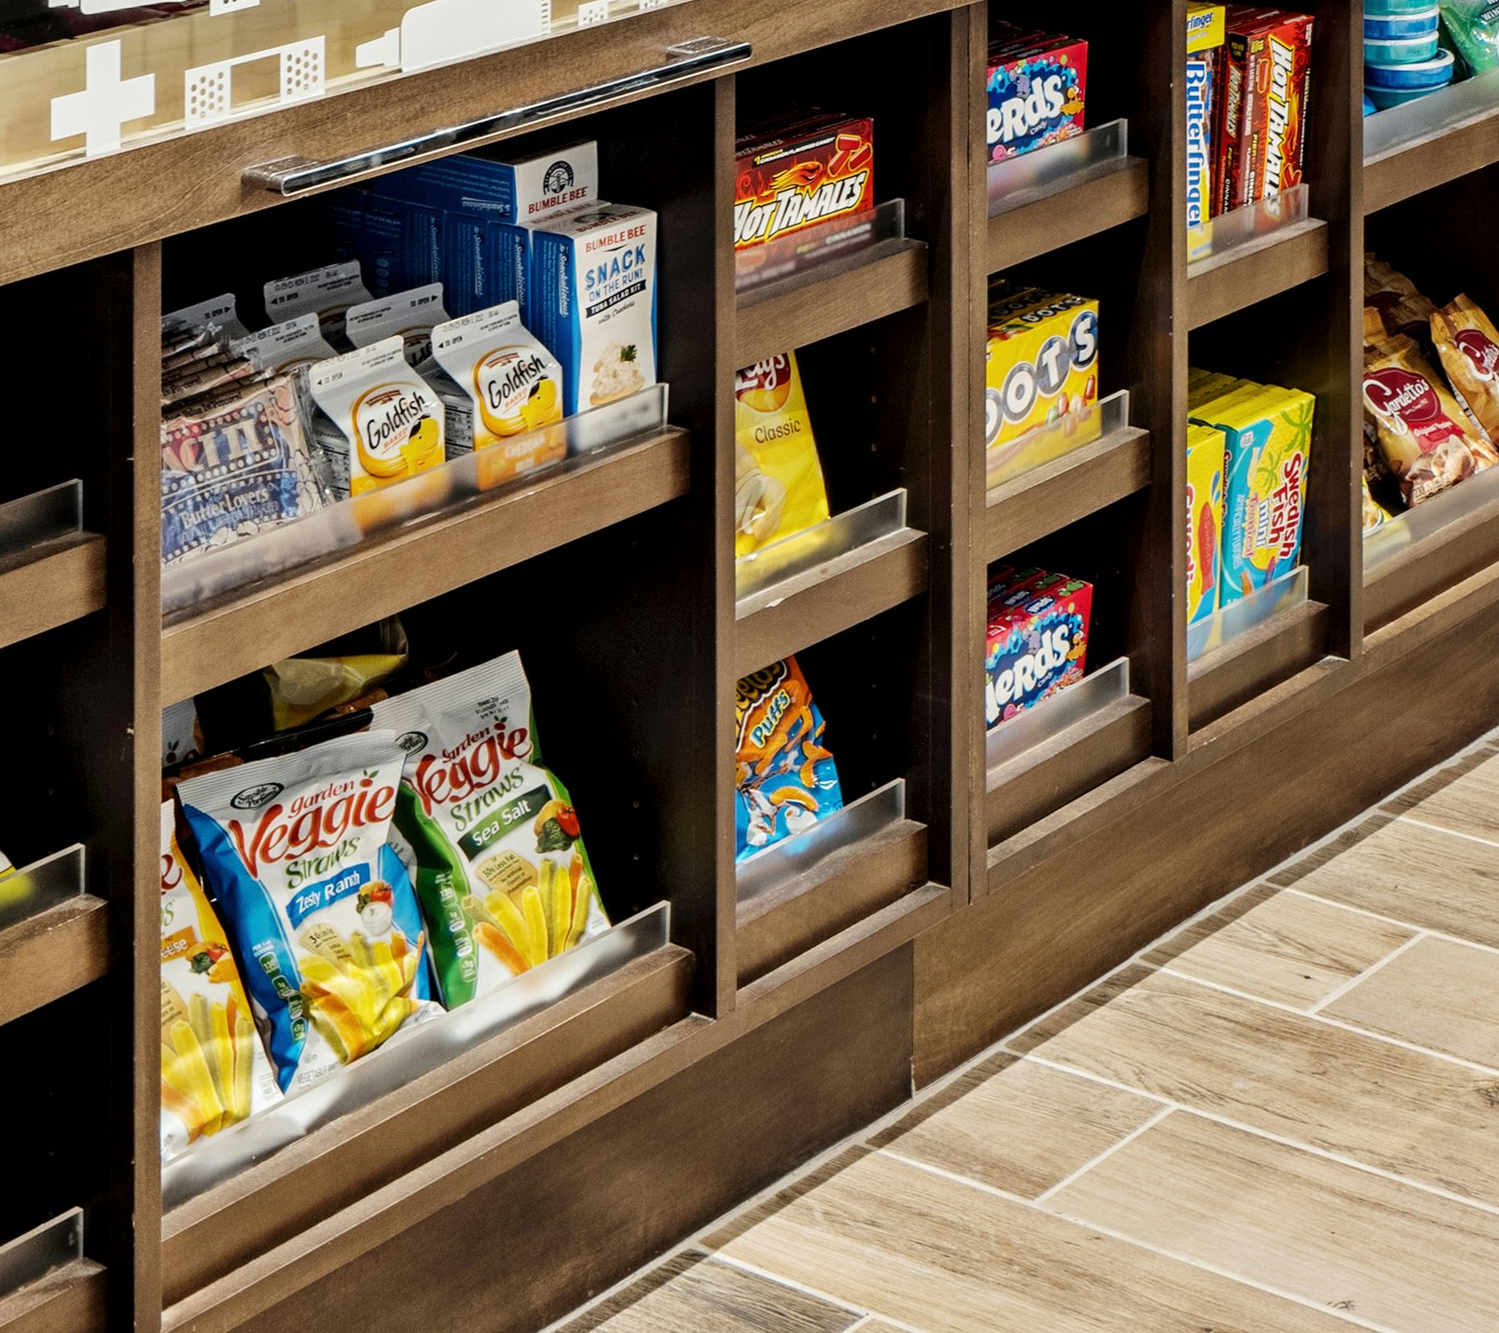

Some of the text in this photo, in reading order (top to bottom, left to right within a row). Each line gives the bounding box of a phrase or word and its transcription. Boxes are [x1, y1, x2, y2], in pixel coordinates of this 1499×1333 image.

[1270, 37, 1294, 101] HOT
[528, 186, 589, 214] BUMBLE BEE
[734, 170, 868, 243] HOT TAMALES
[585, 224, 646, 253] BUMBLE BEE
[584, 243, 646, 290] SNACK
[589, 267, 643, 303] ON THE RUN!
[608, 290, 630, 306] SALAD
[630, 283, 641, 295] KIT
[488, 353, 546, 409] Goldfish
[1362, 377, 1430, 436] Gardetto's
[366, 391, 426, 450] Goldfish
[754, 416, 801, 444] Classic
[180, 485, 270, 530] Butter Lovers
[1268, 483, 1290, 547] Fish
[1279, 451, 1302, 561] Swedish
[749, 689, 791, 749] Puffs
[288, 779, 355, 819] garden
[403, 724, 534, 819] Veggie
[450, 767, 525, 834] Straws
[471, 800, 532, 847] Sea Salt
[228, 781, 396, 880] Veggie
[285, 835, 361, 890] Straws
[295, 870, 361, 915] Zesty Ranch
